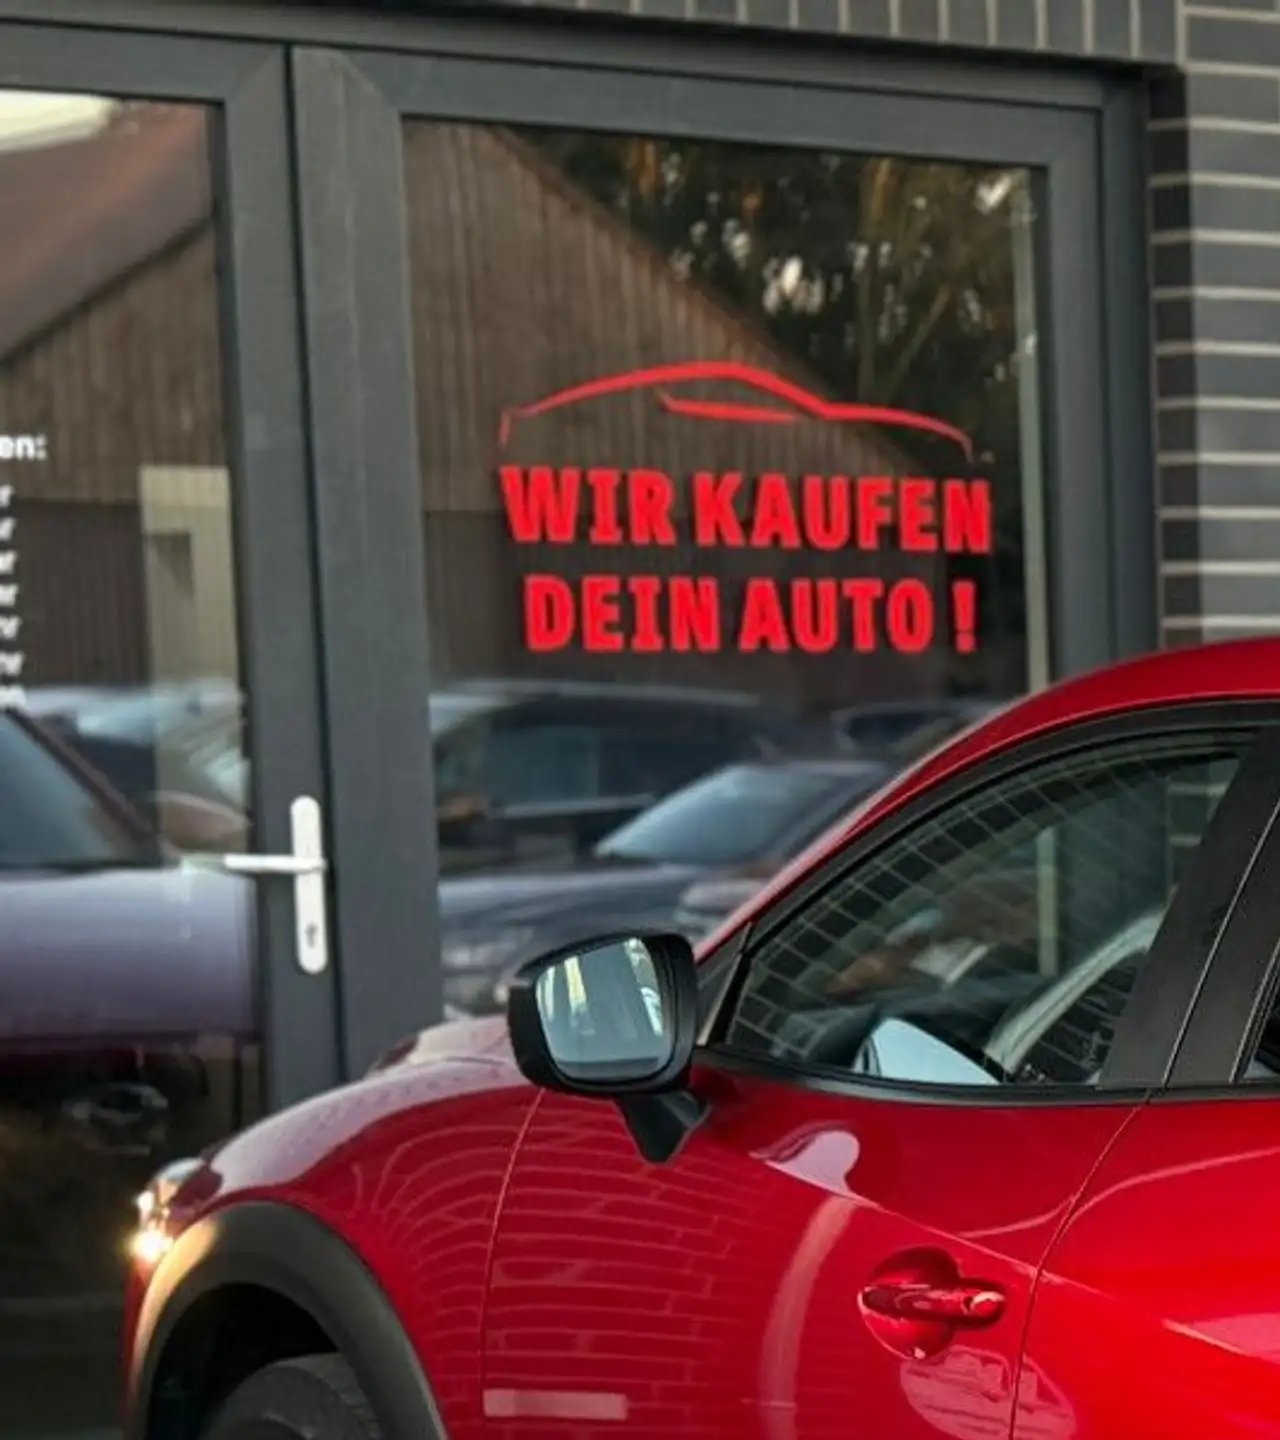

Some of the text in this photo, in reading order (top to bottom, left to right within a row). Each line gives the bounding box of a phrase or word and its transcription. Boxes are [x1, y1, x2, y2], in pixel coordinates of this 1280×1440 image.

[500, 466, 992, 554] WIR KAUFEN
[524, 573, 720, 652] DEIN
[738, 577, 936, 654] AUTO
